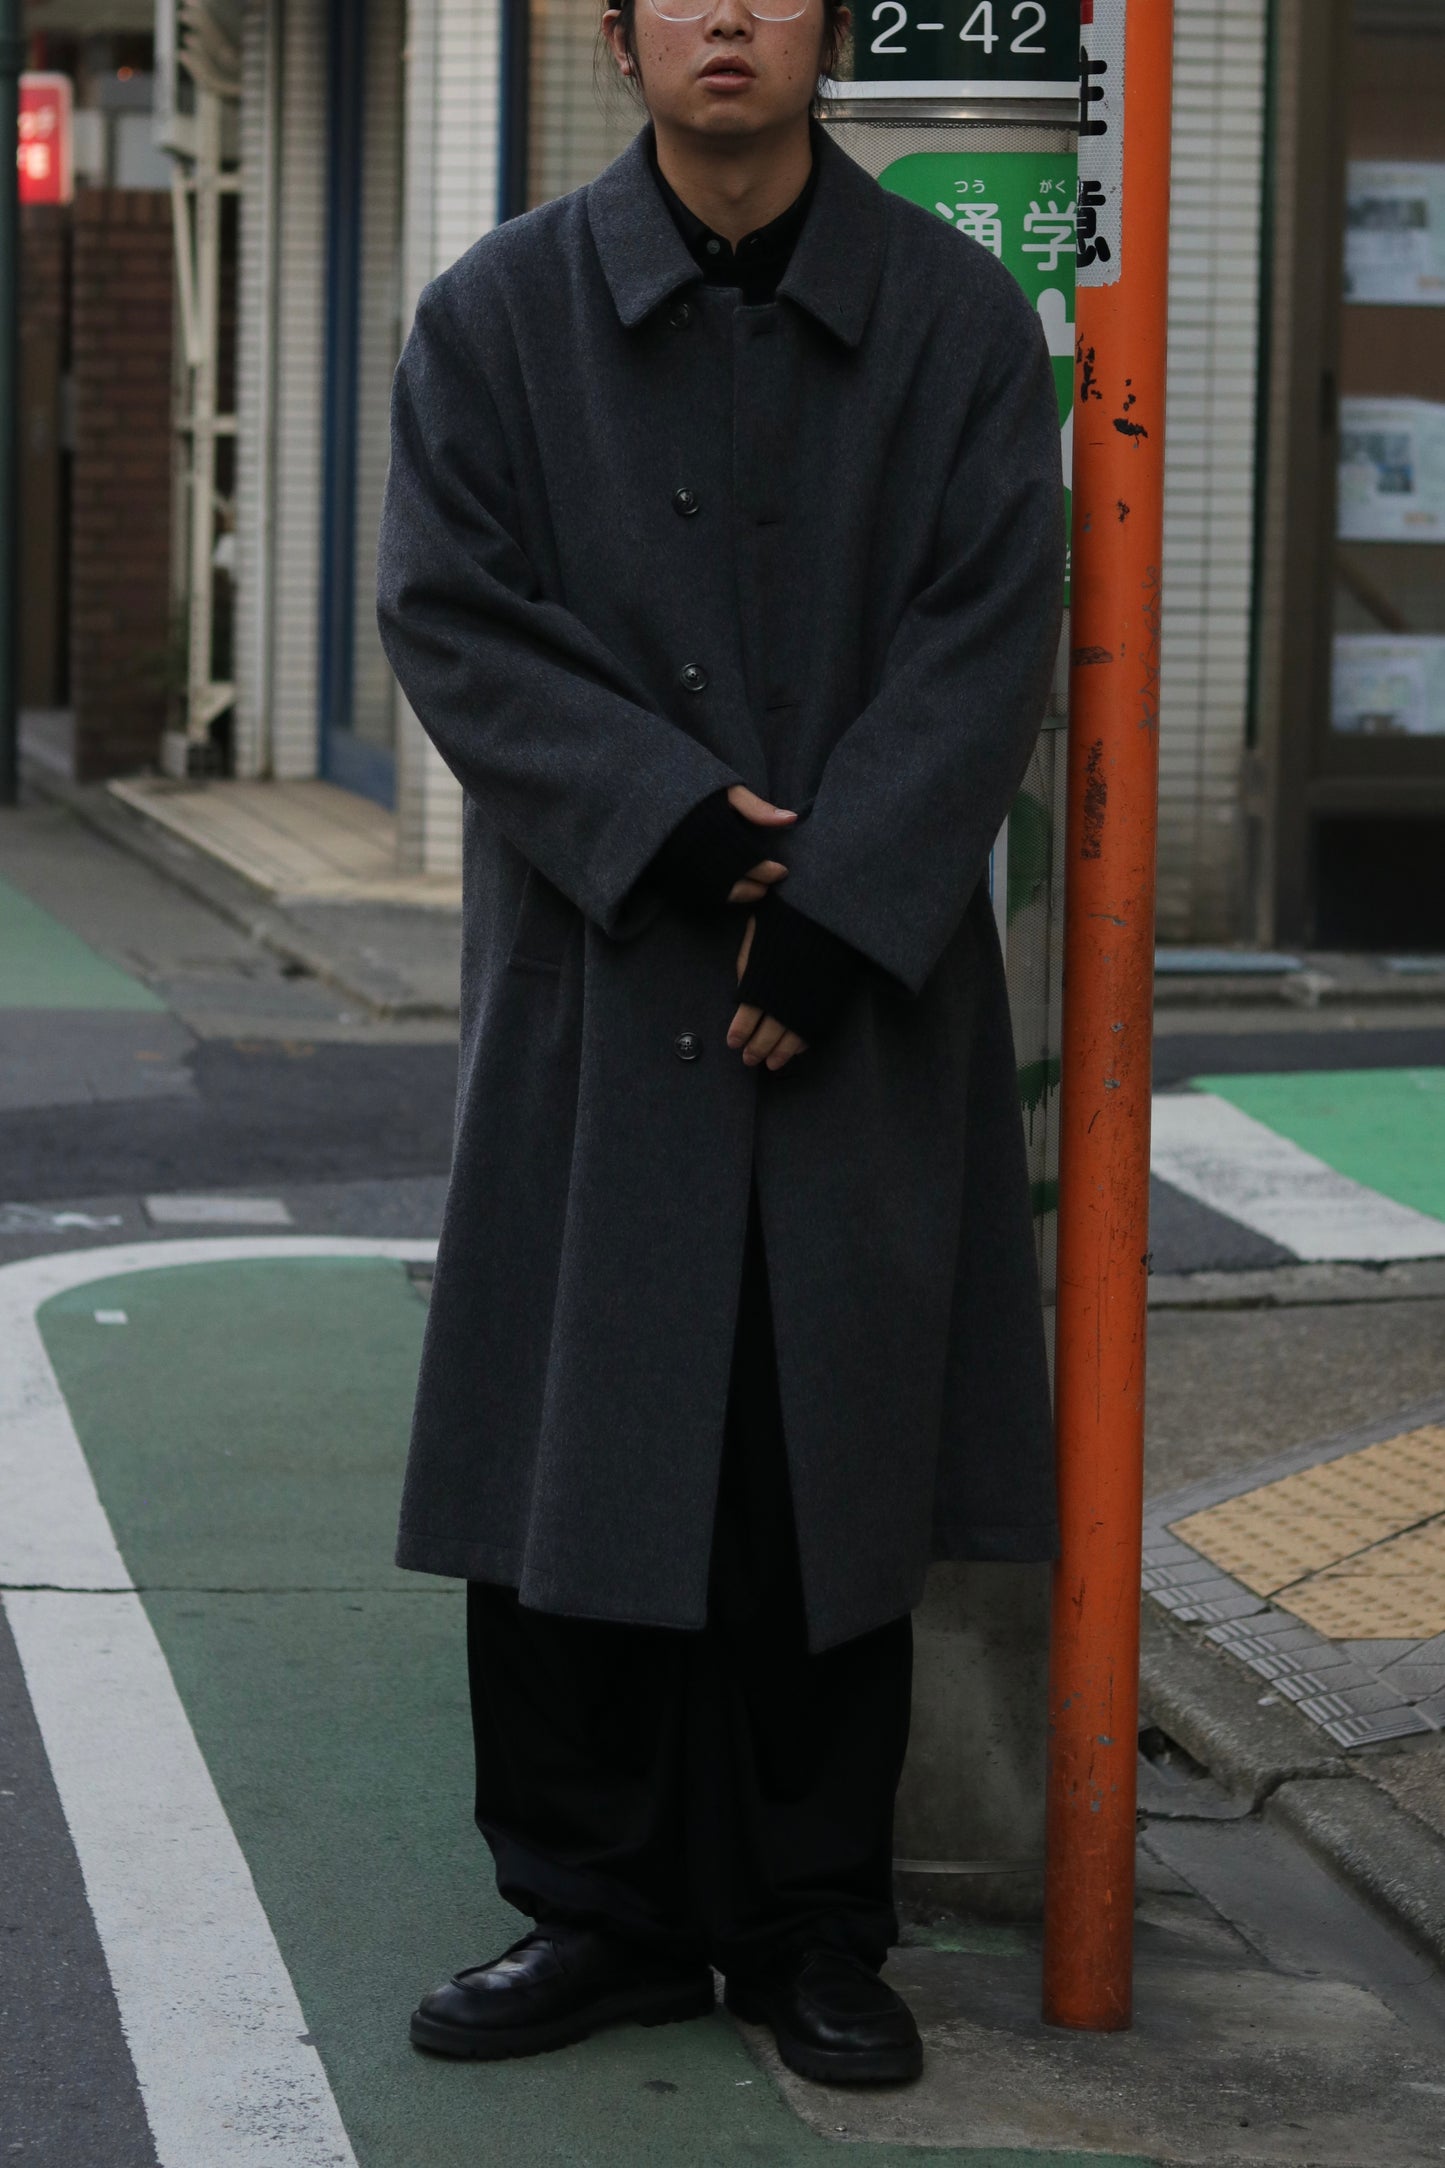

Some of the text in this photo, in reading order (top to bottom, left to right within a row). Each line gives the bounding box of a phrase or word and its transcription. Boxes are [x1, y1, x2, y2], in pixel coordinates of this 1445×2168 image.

[870, 1, 1047, 54] 2-42
[954, 179, 1067, 194] つう がく
